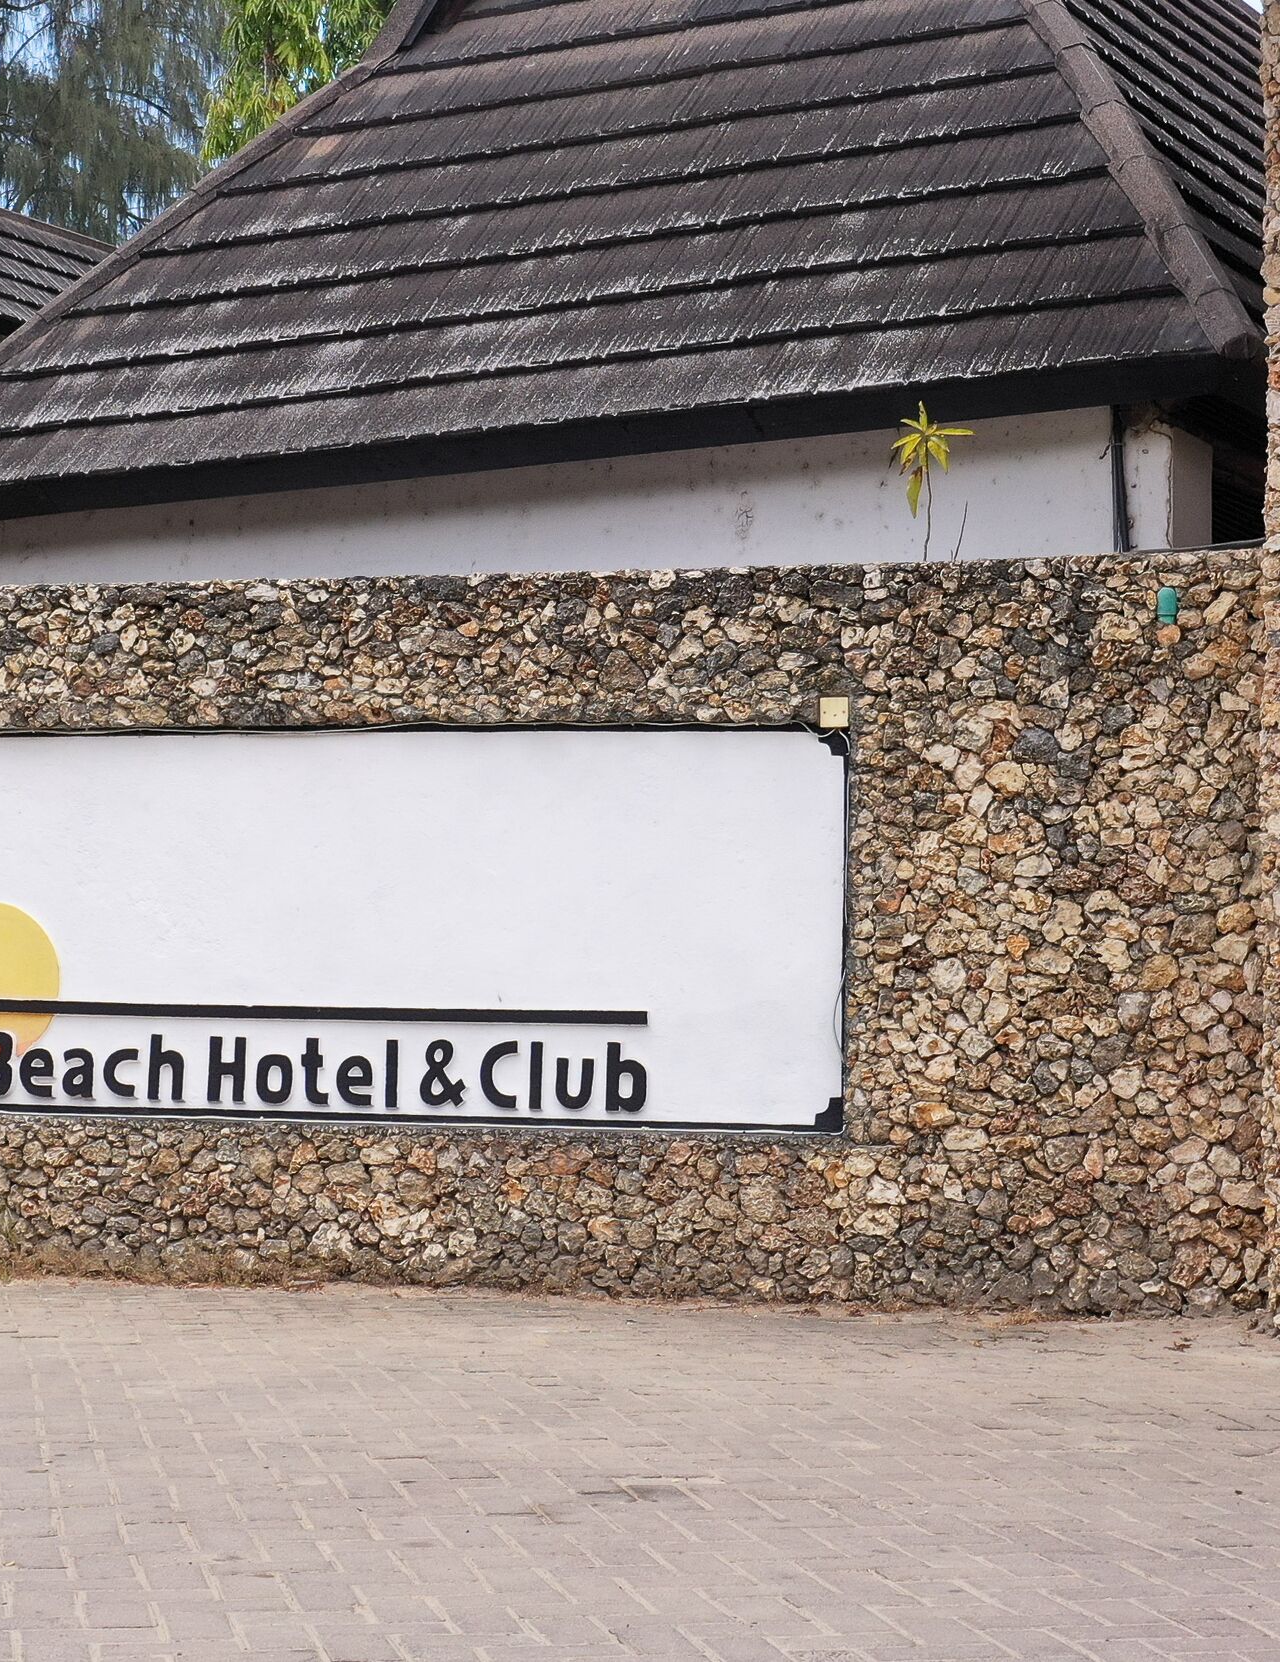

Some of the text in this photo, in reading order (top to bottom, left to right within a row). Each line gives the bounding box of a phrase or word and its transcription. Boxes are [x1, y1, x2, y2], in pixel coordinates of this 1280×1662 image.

[206, 1035, 399, 1108] Hotel
[419, 1039, 466, 1108] &
[479, 1040, 648, 1113] Club
